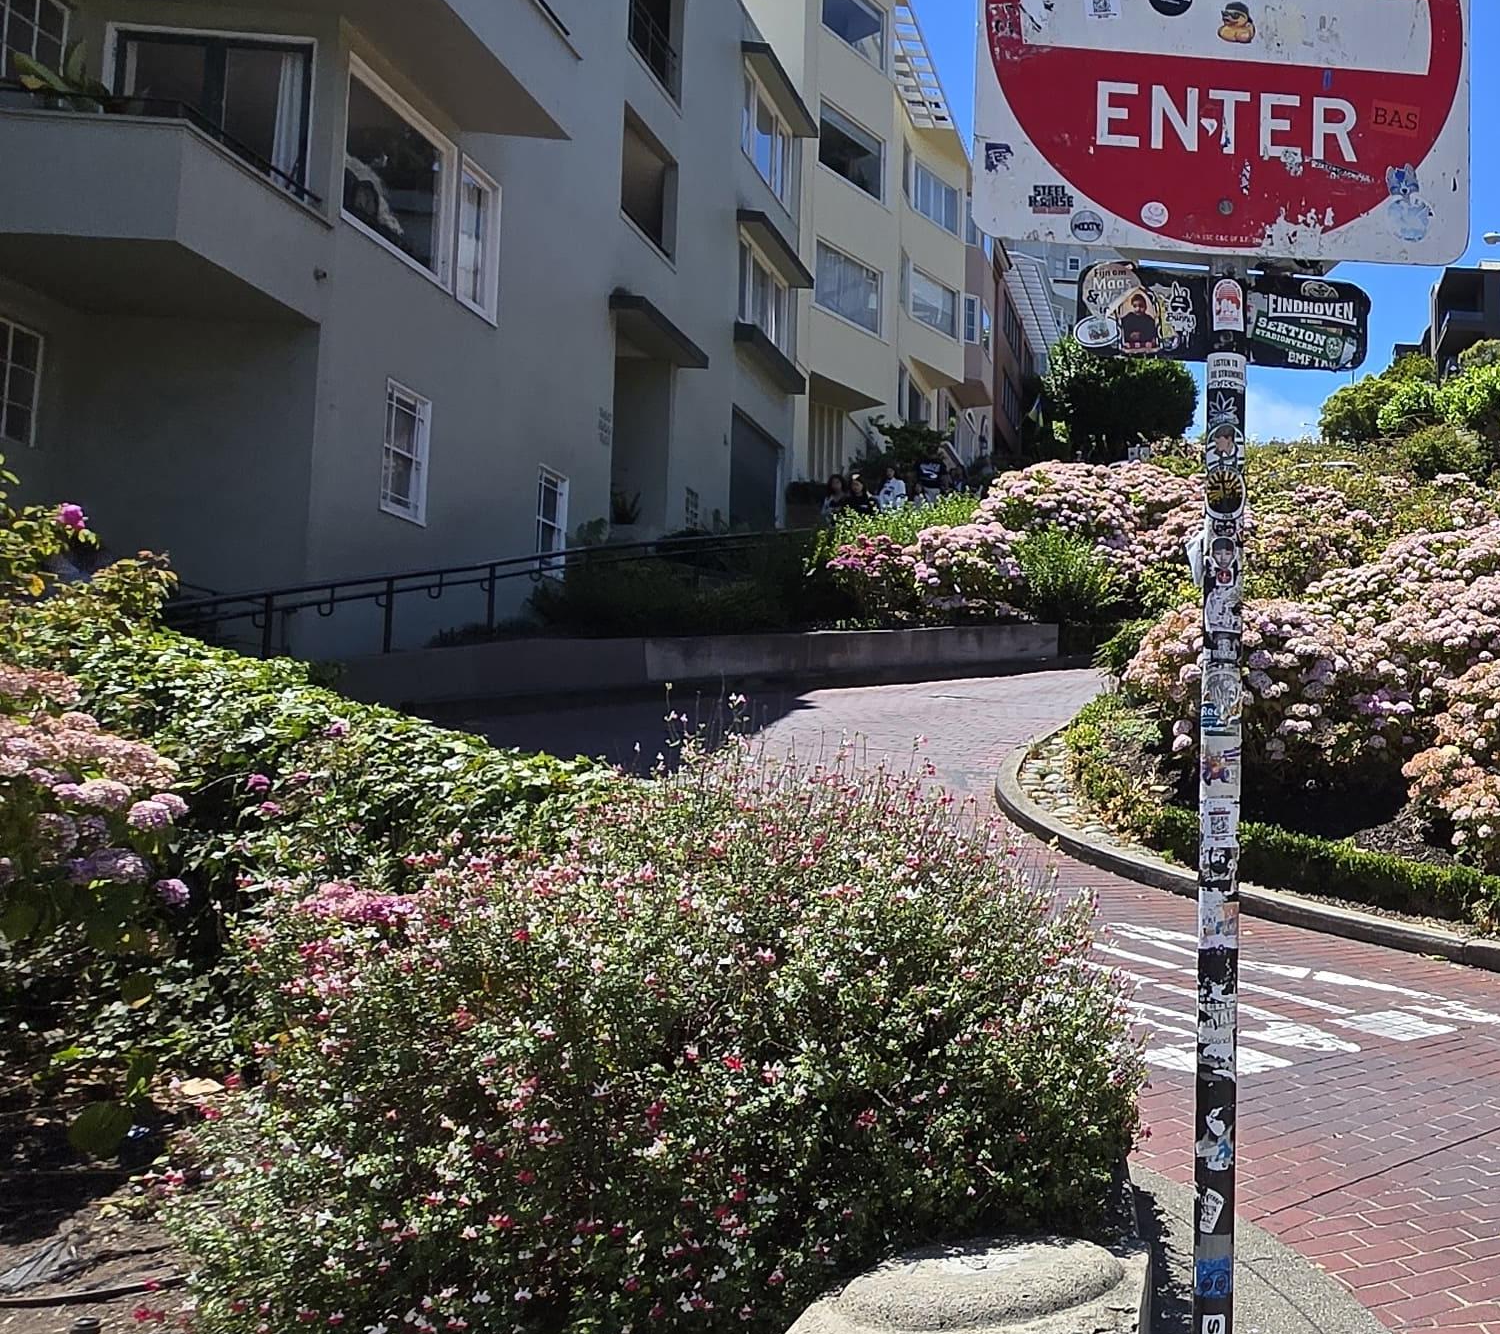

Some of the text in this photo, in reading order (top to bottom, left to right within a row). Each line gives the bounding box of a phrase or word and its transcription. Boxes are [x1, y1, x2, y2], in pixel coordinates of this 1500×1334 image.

[1096, 80, 1357, 163] ENTER
[1373, 107, 1418, 131] BAS
[1033, 184, 1068, 196] STEEL
[1093, 277, 1132, 290] Maas
[1094, 268, 1111, 278] Fijn
[1255, 328, 1324, 354] STADIONVERBOT
[1257, 317, 1327, 346] SEKTION
